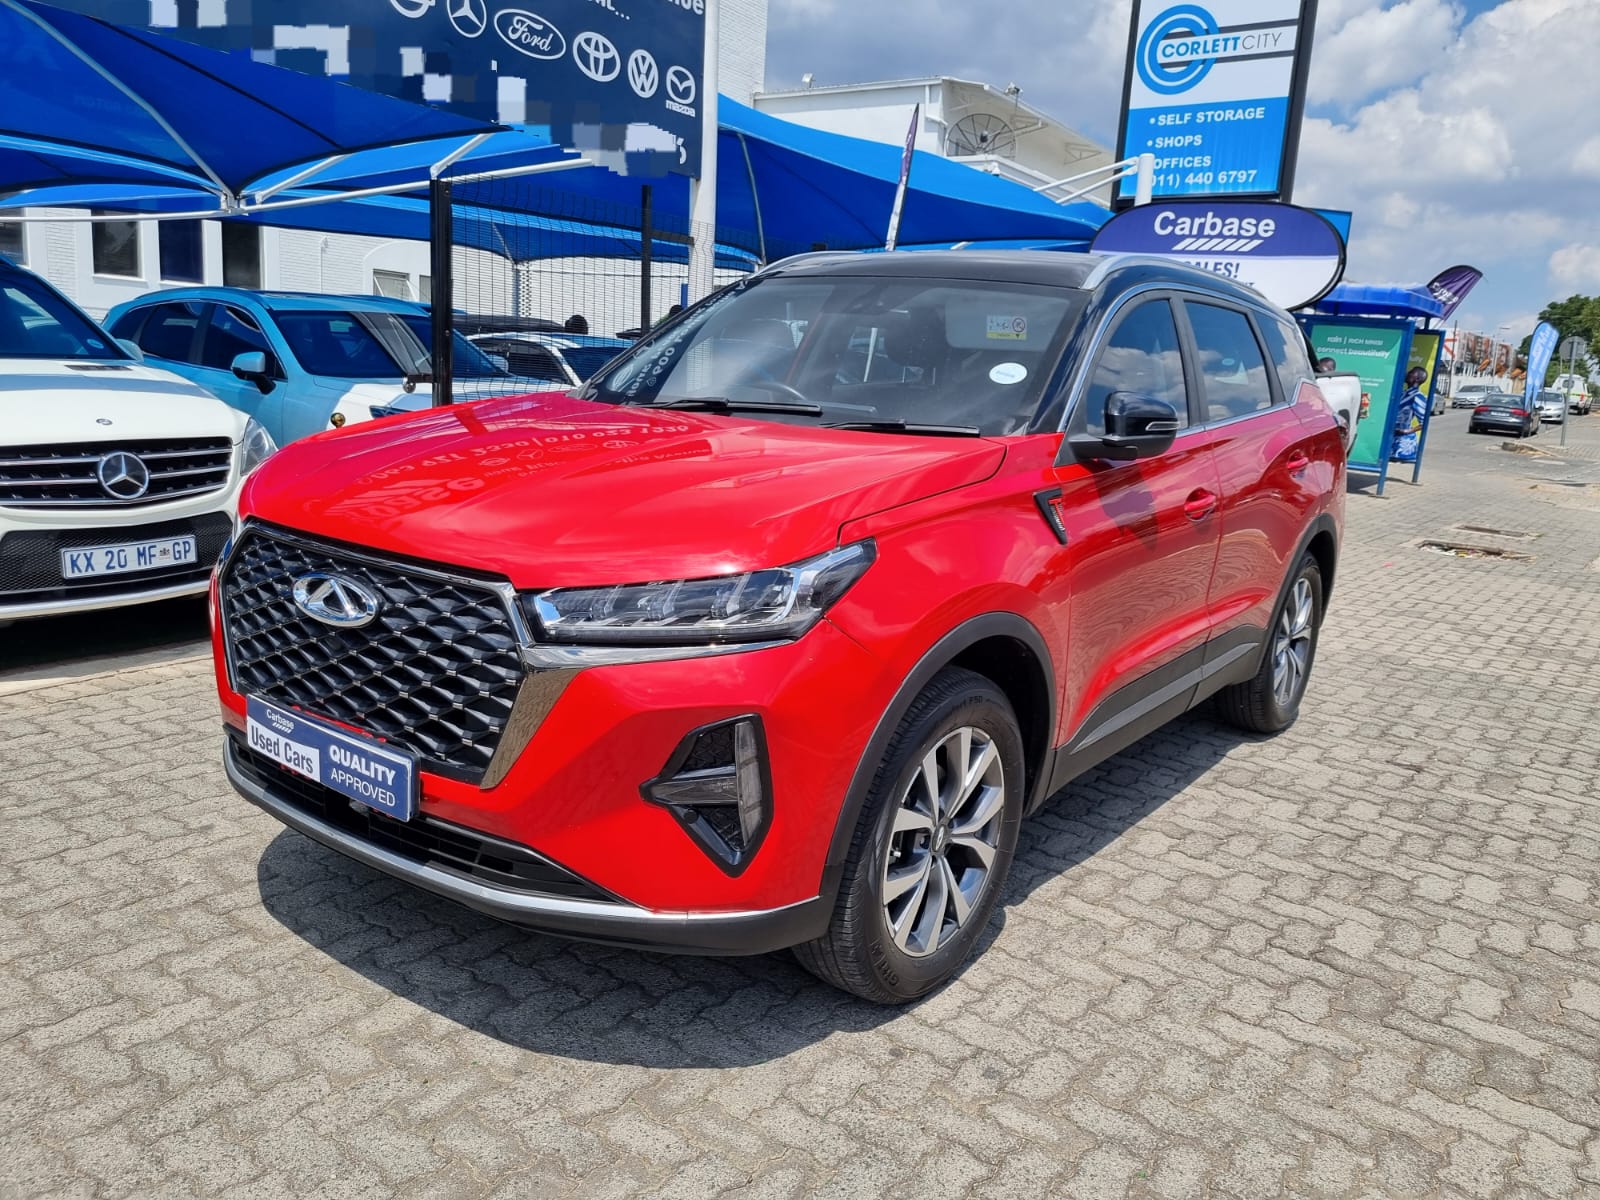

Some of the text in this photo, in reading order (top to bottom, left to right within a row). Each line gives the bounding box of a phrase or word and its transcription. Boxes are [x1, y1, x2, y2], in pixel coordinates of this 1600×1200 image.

[507, 16, 555, 53] Ford
[1162, 32, 1282, 58] CORLETT CITY
[1158, 107, 1265, 126] SELF STORAGE
[1155, 135, 1202, 148] SHOPS
[1154, 156, 1211, 169] OFFICES
[1185, 172, 1213, 185] 440
[1218, 170, 1257, 183] 6797
[1154, 211, 1275, 238] Carbase
[70, 540, 191, 574] KX 20 MF GP
[266, 709, 295, 729] Carbase
[251, 725, 314, 774] Used Cars
[329, 744, 396, 786] QUALITY
[330, 768, 396, 807] APPROVED
